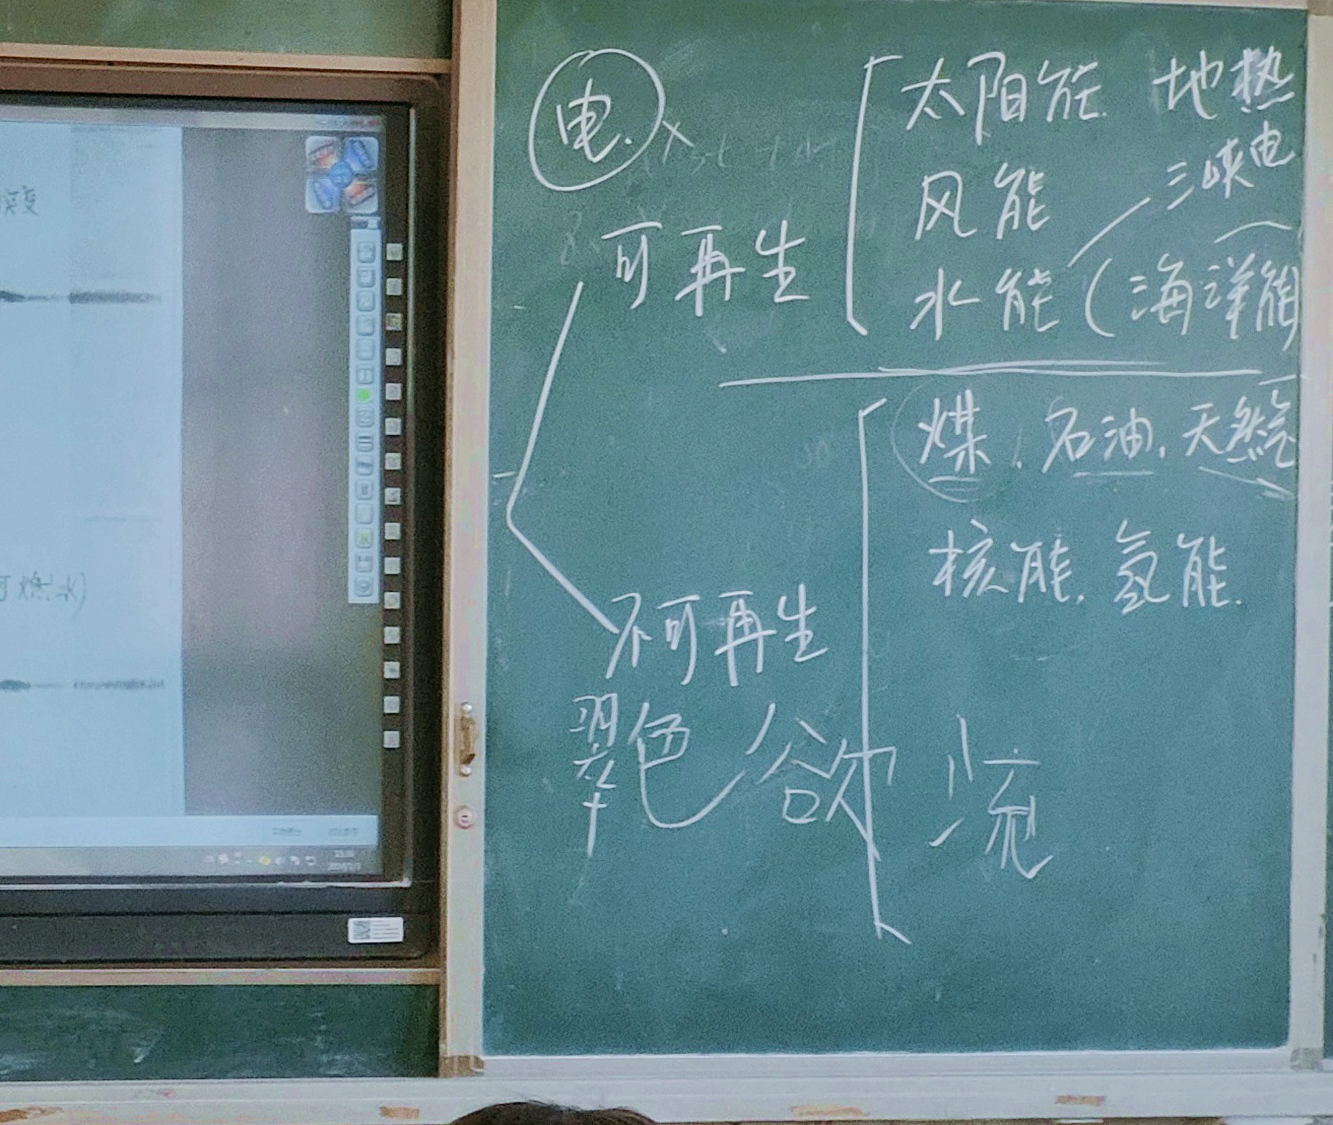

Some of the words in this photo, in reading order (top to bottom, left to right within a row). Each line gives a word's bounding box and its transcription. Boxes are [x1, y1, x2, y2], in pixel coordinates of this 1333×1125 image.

[556, 79, 616, 163] 电
[901, 51, 1101, 146] 太阳能
[1153, 45, 1295, 120] 地热
[915, 162, 1051, 240] 风能
[603, 219, 811, 316] 可再生
[605, 583, 830, 687] 不可再生
